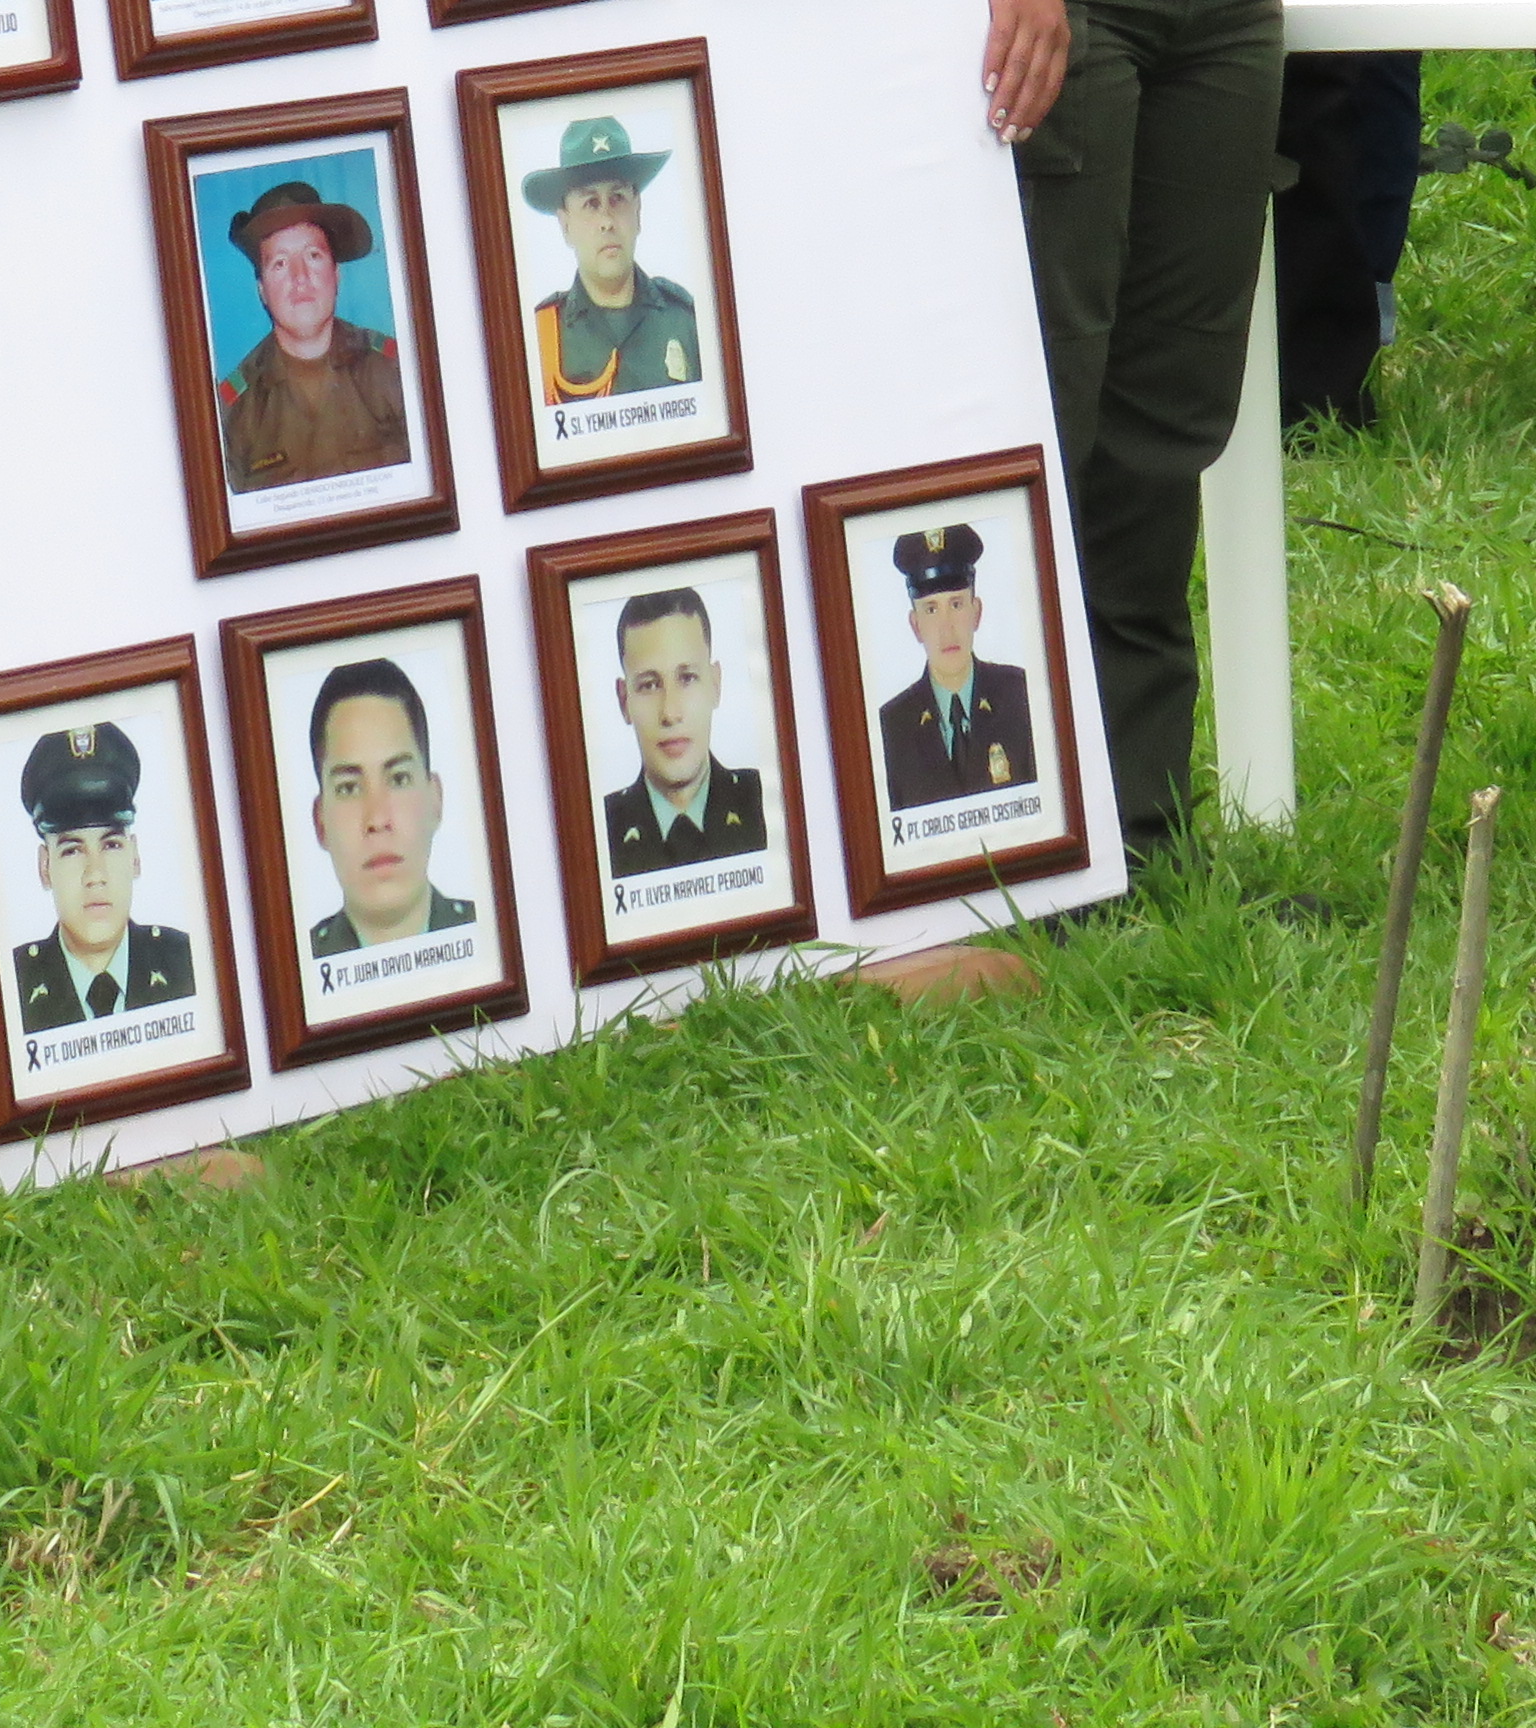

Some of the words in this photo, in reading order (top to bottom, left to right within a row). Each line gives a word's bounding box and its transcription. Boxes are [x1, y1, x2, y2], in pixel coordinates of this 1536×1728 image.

[619, 401, 658, 428] ESPAÑA
[658, 397, 698, 420] VARGAS
[922, 813, 956, 838] CARLOS
[672, 873, 716, 901] NARVAEZ
[717, 865, 765, 893] PERDOMO
[353, 960, 380, 985] JUAN
[380, 952, 413, 978] DAVID
[414, 937, 475, 969] MARMOLEJO
[61, 1034, 99, 1061] DUVAN
[99, 1024, 143, 1052] FRANCO
[144, 1011, 196, 1042] GONZALEZ
